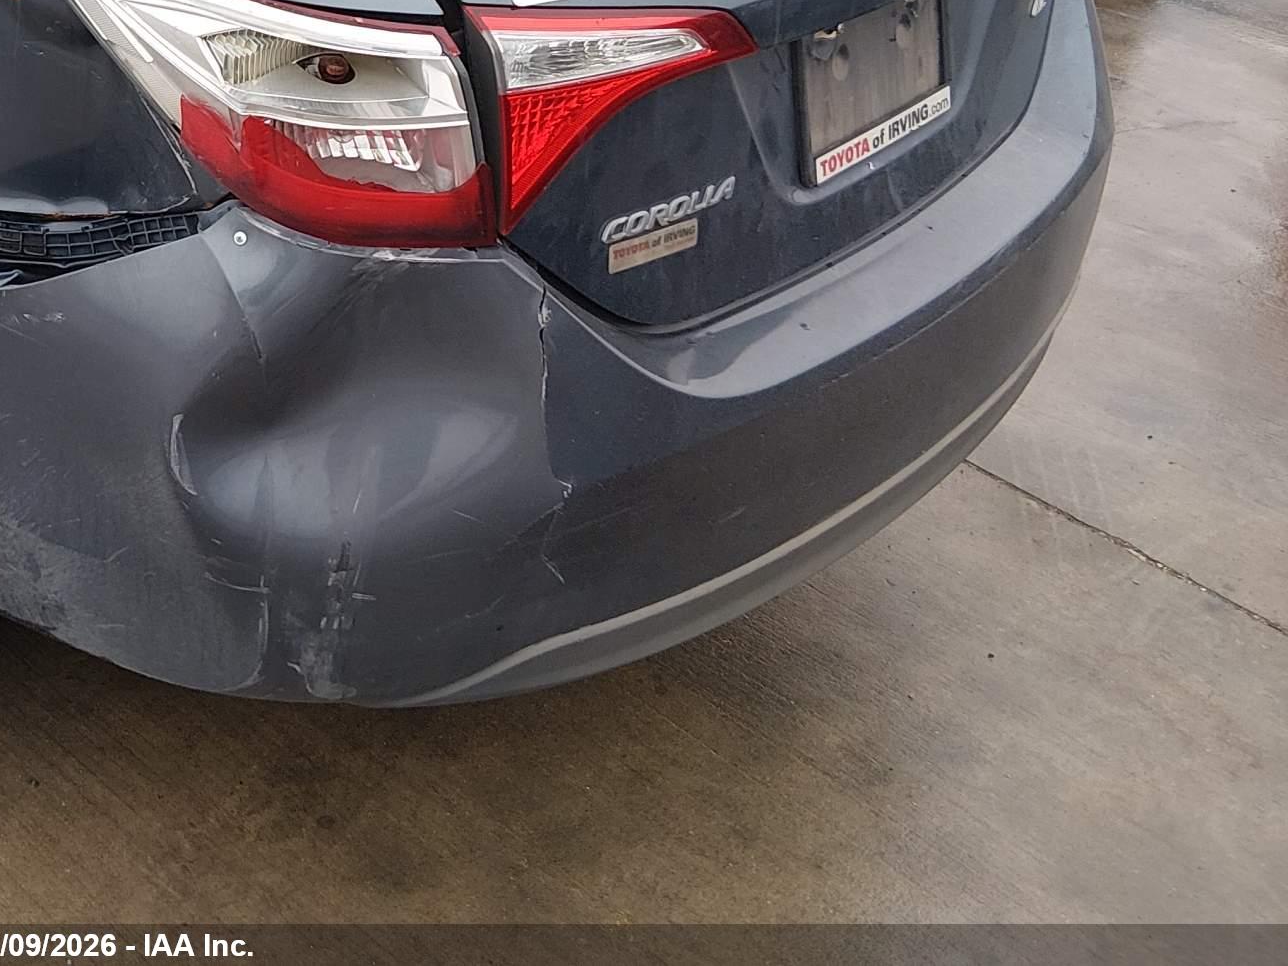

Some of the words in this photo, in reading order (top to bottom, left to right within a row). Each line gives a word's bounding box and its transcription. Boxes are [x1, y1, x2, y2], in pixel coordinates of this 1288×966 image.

[820, 138, 870, 176] TOYOTA
[872, 128, 885, 149] of
[601, 176, 736, 243] COROLLA
[612, 240, 650, 260] TOYOTA
[651, 235, 661, 247] of
[663, 226, 696, 244] IRVING
